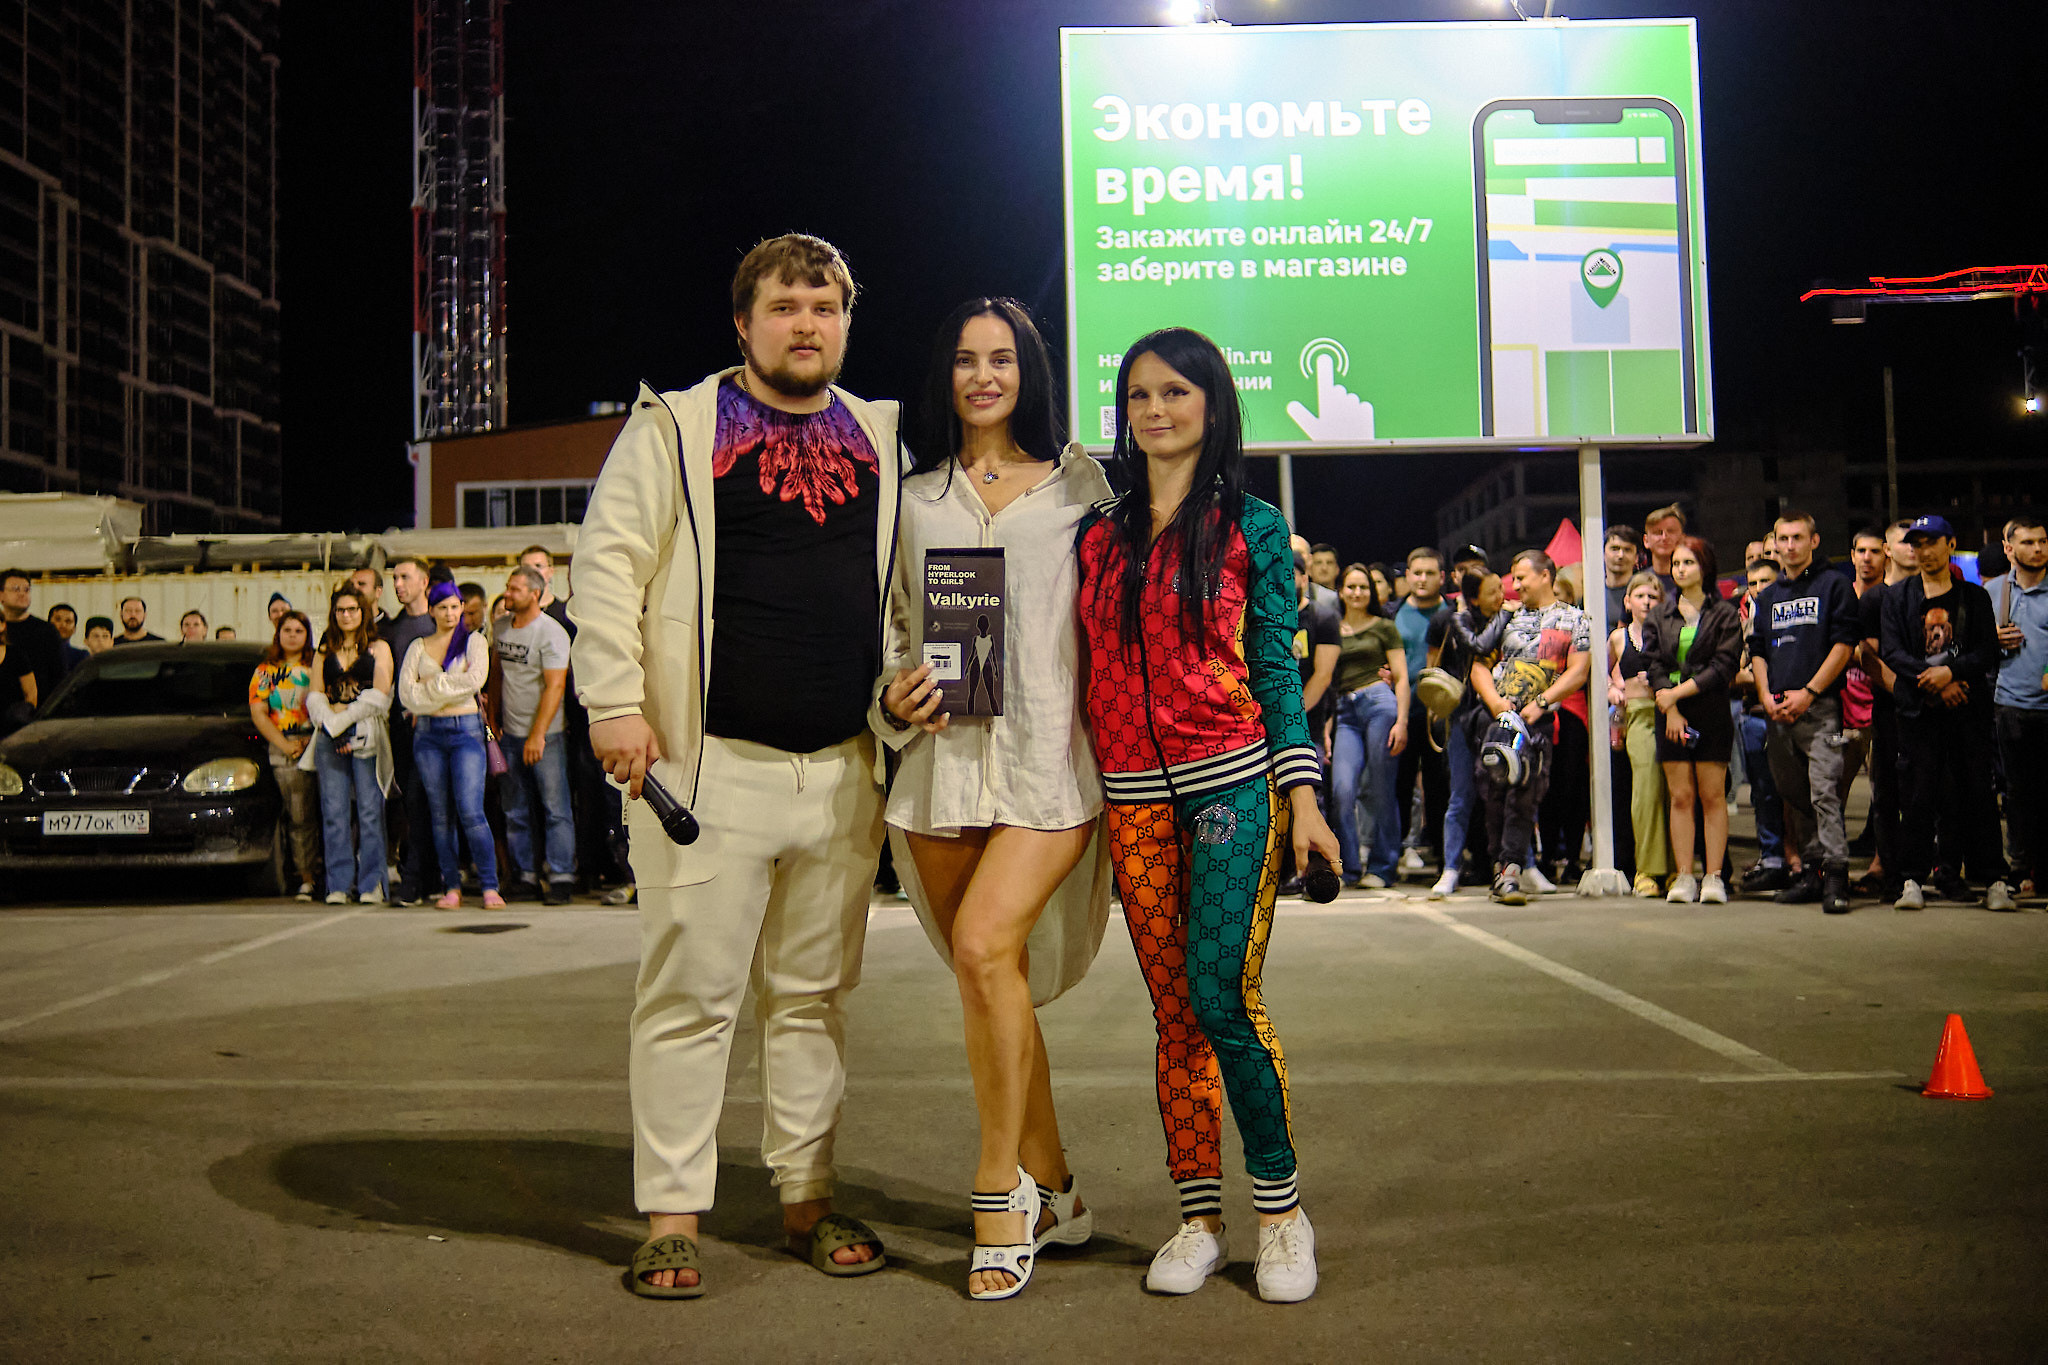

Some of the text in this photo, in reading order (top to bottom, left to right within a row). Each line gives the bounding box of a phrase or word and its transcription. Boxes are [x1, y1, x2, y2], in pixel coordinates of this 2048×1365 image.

[1092, 94, 1432, 142] Экономьте
[1096, 153, 1304, 215] время!
[1096, 216, 1434, 249] Закажите онлайн 24/7
[1097, 255, 1408, 286] заберите в магазине
[928, 592, 1001, 609] Valkyrie
